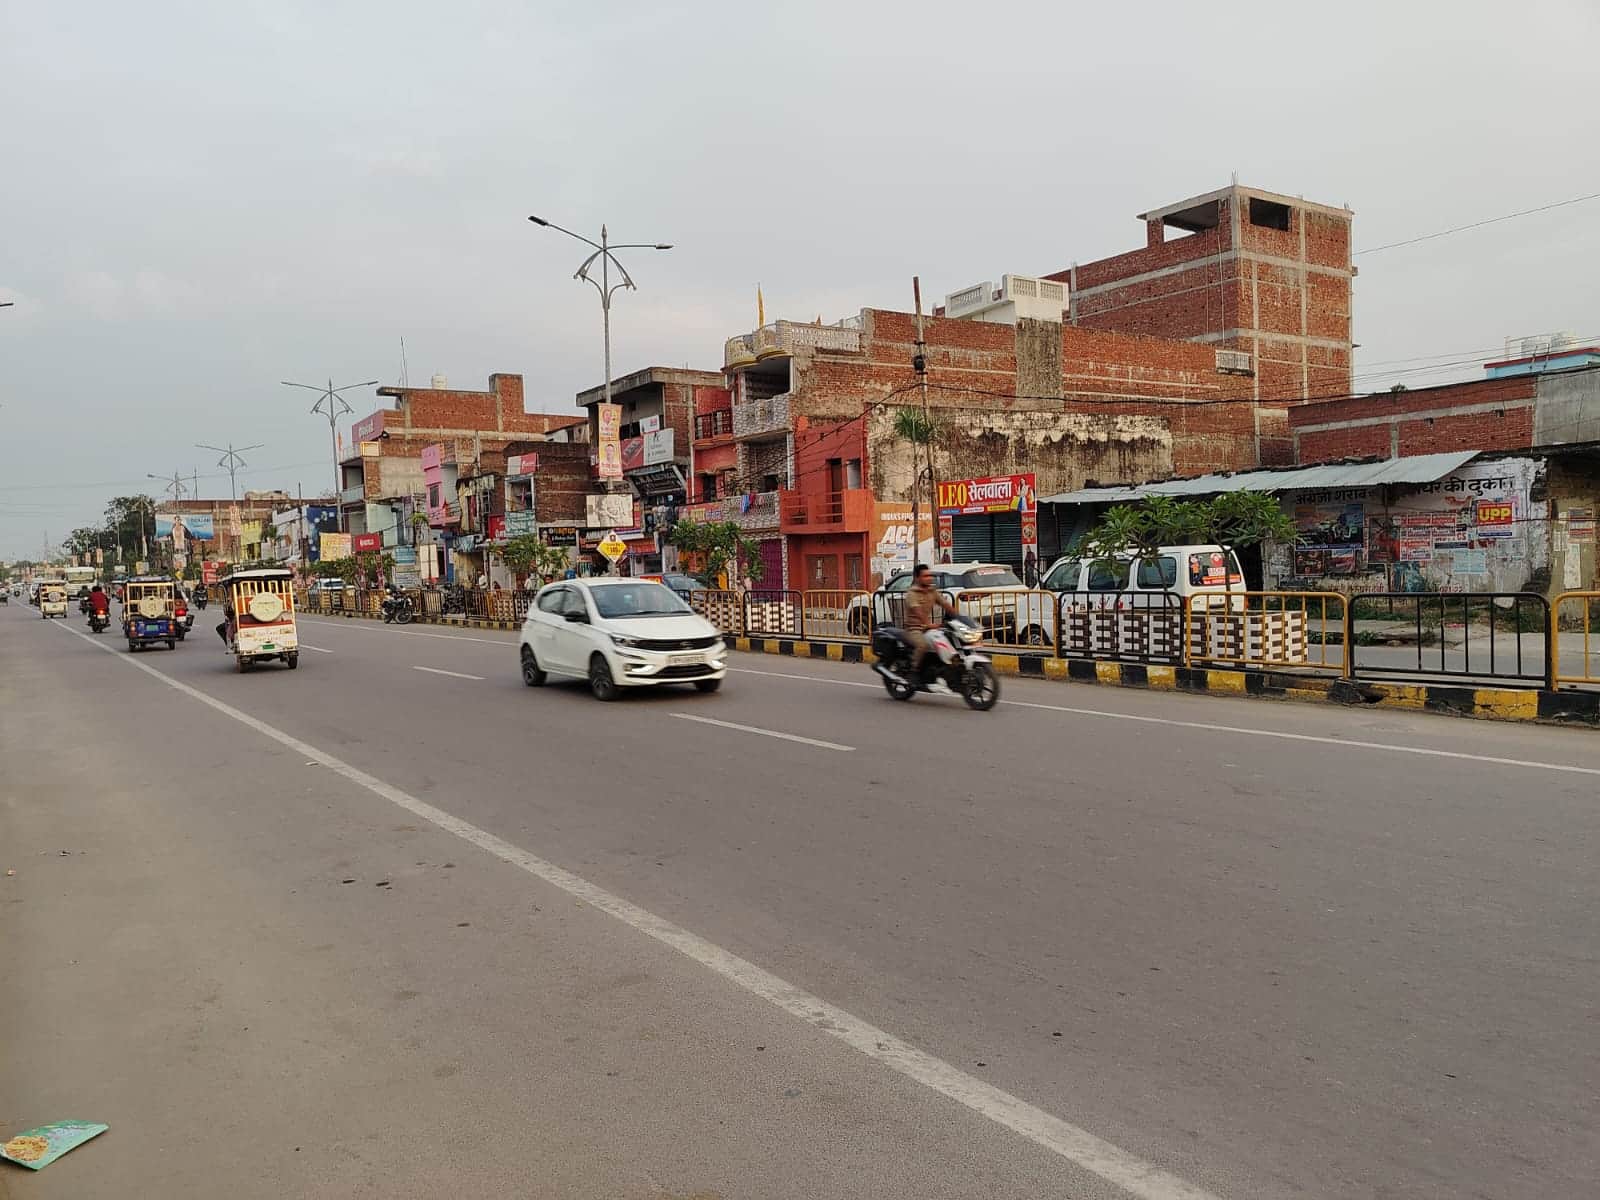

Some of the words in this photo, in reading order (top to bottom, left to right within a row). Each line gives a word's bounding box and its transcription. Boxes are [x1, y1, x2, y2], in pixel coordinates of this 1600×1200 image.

[1444, 476, 1464, 493] की
[938, 483, 968, 507] LEO
[968, 481, 1012, 501] सेलवाला
[1479, 508, 1511, 521] UPP
